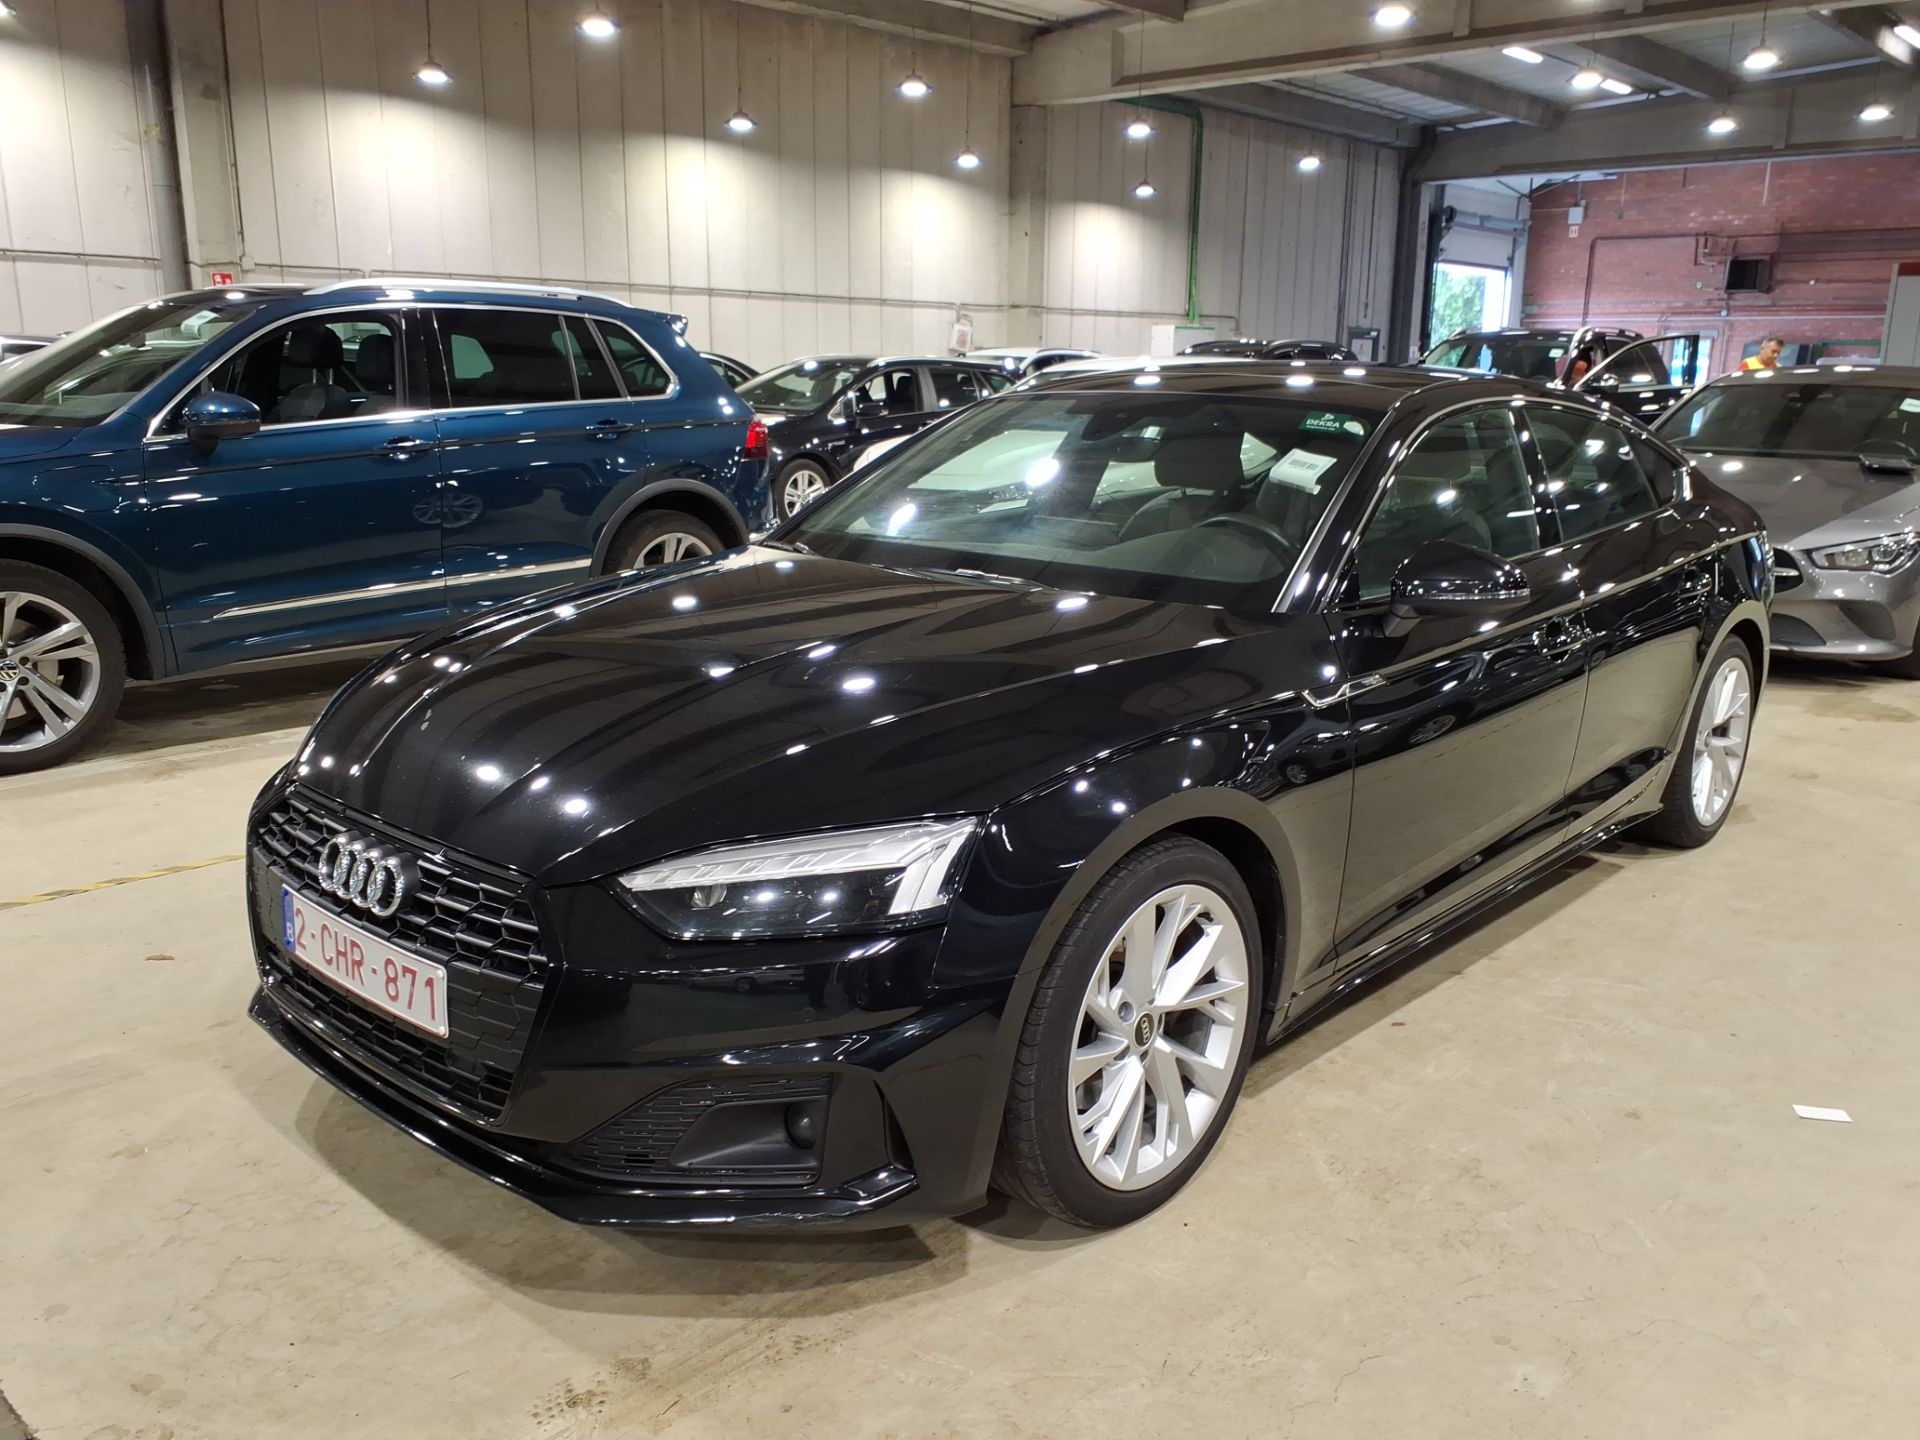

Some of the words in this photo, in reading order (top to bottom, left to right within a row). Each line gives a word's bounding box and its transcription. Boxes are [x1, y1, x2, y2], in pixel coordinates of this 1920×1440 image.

[1306, 418, 1340, 429] DEKRA
[286, 923, 294, 941] B
[295, 908, 436, 1021] 2-CHR-871
